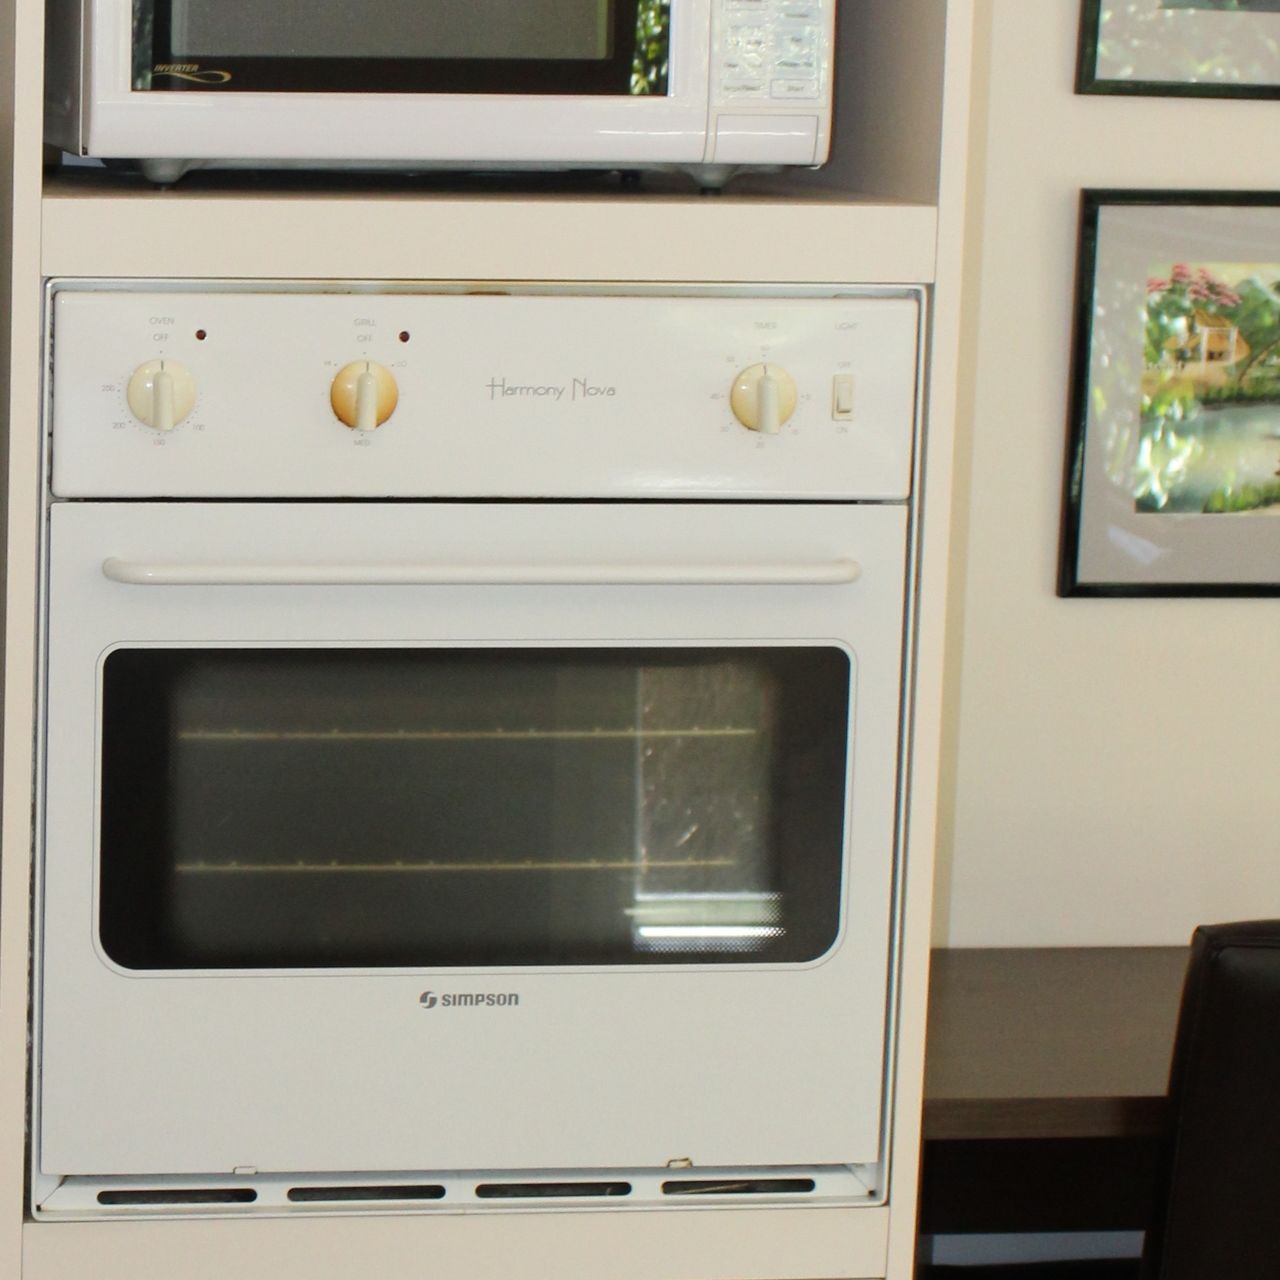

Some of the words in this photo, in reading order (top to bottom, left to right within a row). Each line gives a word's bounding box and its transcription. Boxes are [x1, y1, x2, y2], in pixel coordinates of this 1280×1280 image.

[153, 64, 200, 72] INVERTER
[485, 377, 565, 401] Harmony
[571, 377, 616, 401] Nova
[441, 993, 519, 1007] SIMPSON
